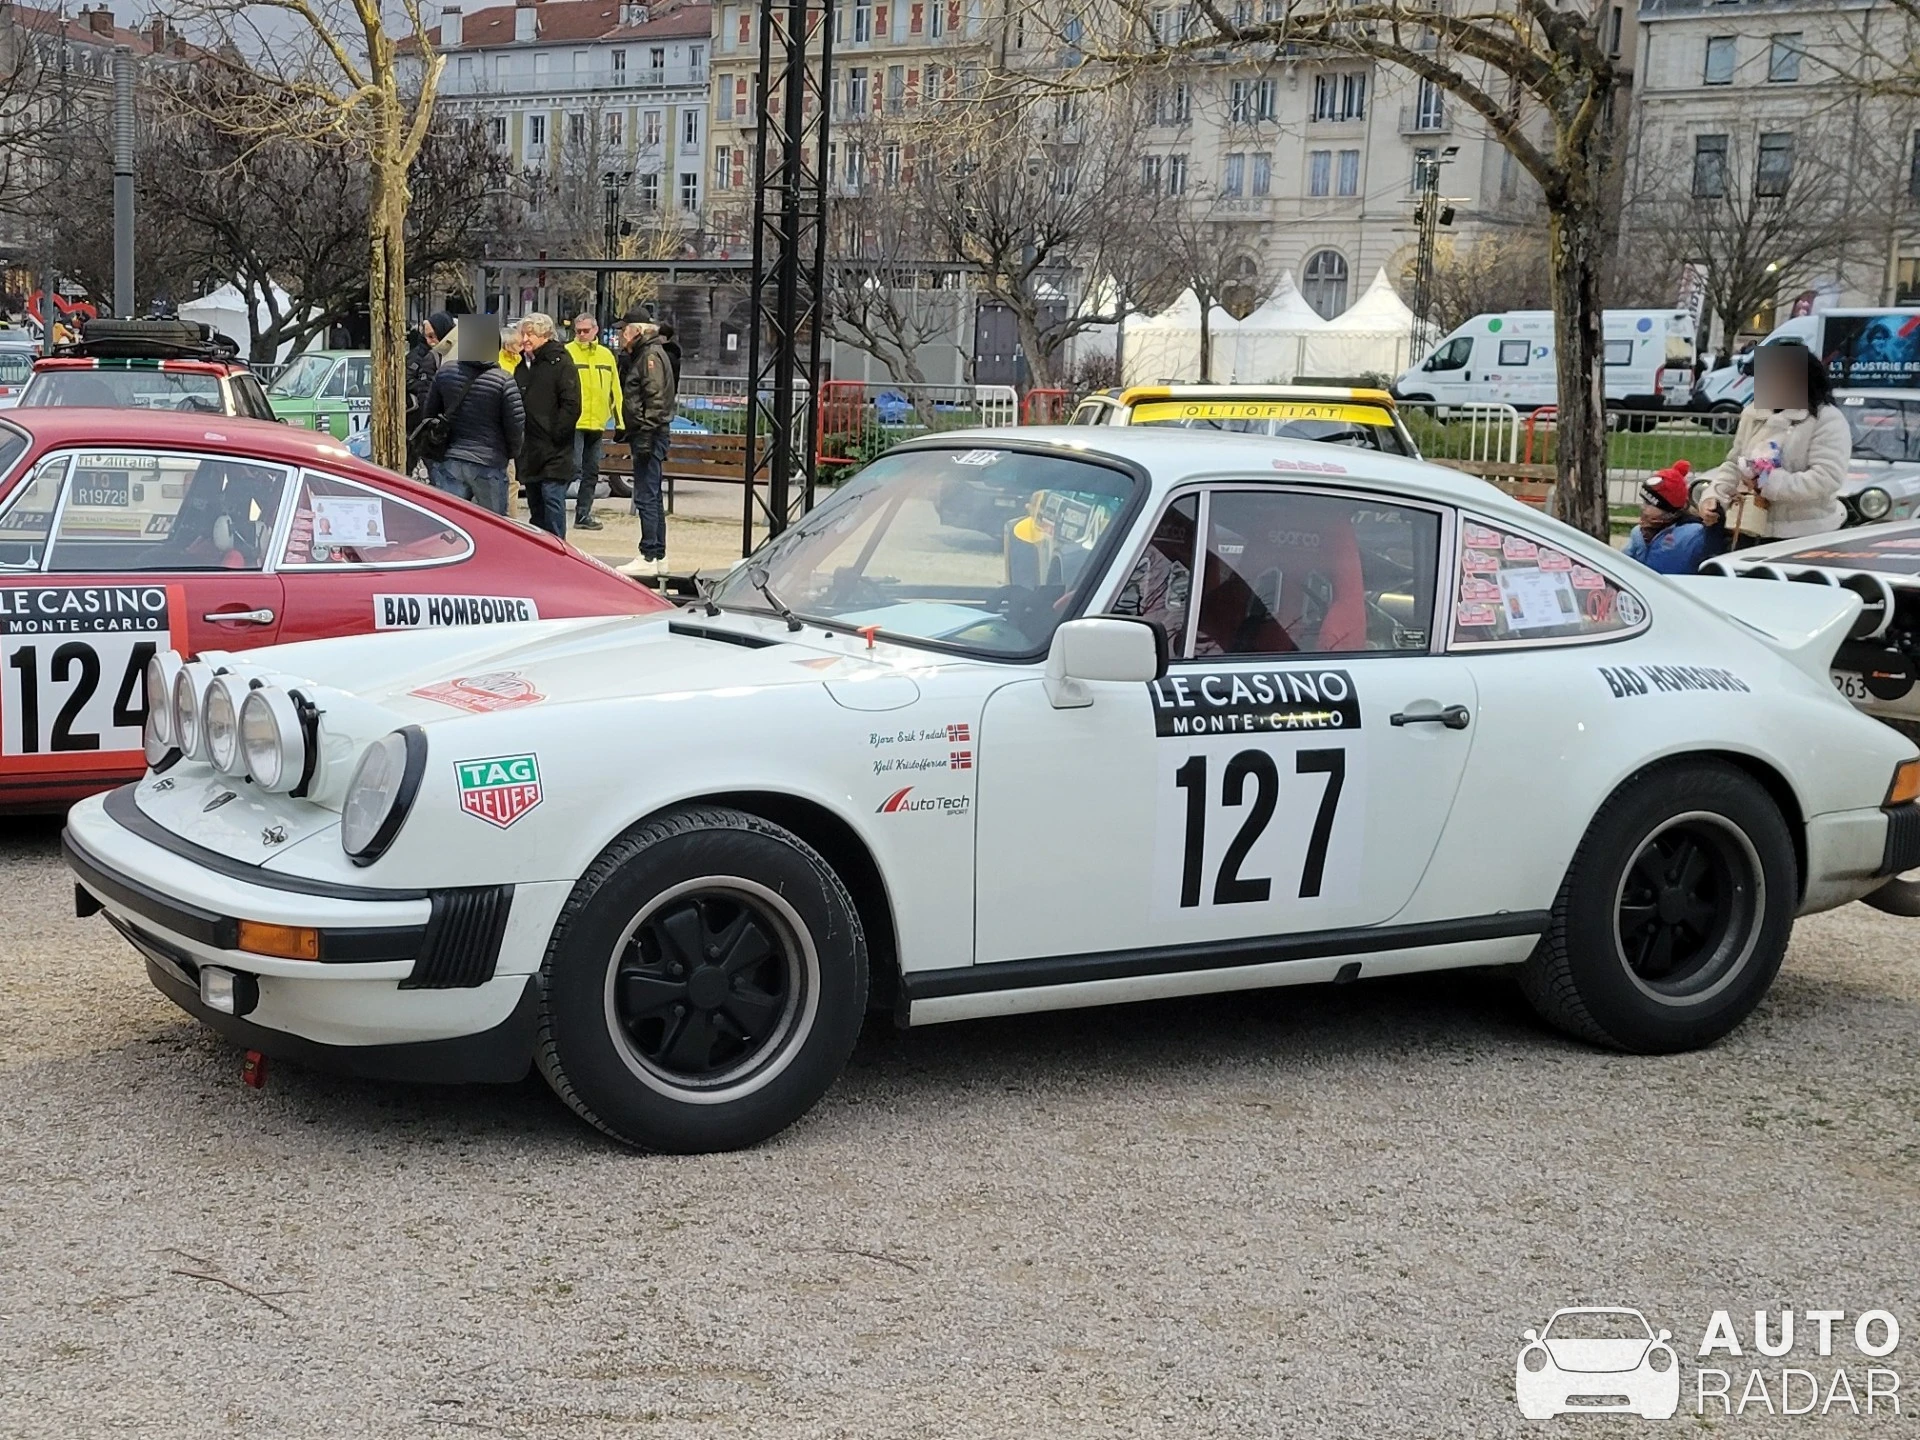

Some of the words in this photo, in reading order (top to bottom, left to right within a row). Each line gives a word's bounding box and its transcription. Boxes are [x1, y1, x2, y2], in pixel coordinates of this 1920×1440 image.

[1185, 405, 1338, 418] OLIOFIAT
[103, 457, 156, 468] Alitalia
[79, 488, 127, 504] R19728
[0, 591, 30, 614] LE
[38, 589, 165, 613] CASINO
[384, 597, 420, 625] BAD
[428, 597, 529, 626] HOMBOURG
[10, 619, 80, 632] MONTE
[94, 617, 158, 630] CARLO
[1153, 677, 1196, 708] LE
[1200, 672, 1348, 706] CASINO
[1598, 666, 1648, 698] BAD
[1642, 665, 1751, 693] HOMBOURG
[10, 641, 156, 753] 124
[1174, 716, 1254, 734] MONTE
[1270, 710, 1343, 730] CARLO
[897, 731, 916, 742] Erik
[464, 760, 531, 786] TAG
[873, 759, 893, 776] Kjell
[467, 786, 536, 822] HEUER
[899, 795, 970, 812] AutoTech
[947, 808, 968, 816] SPORT
[1176, 748, 1345, 908] 127
